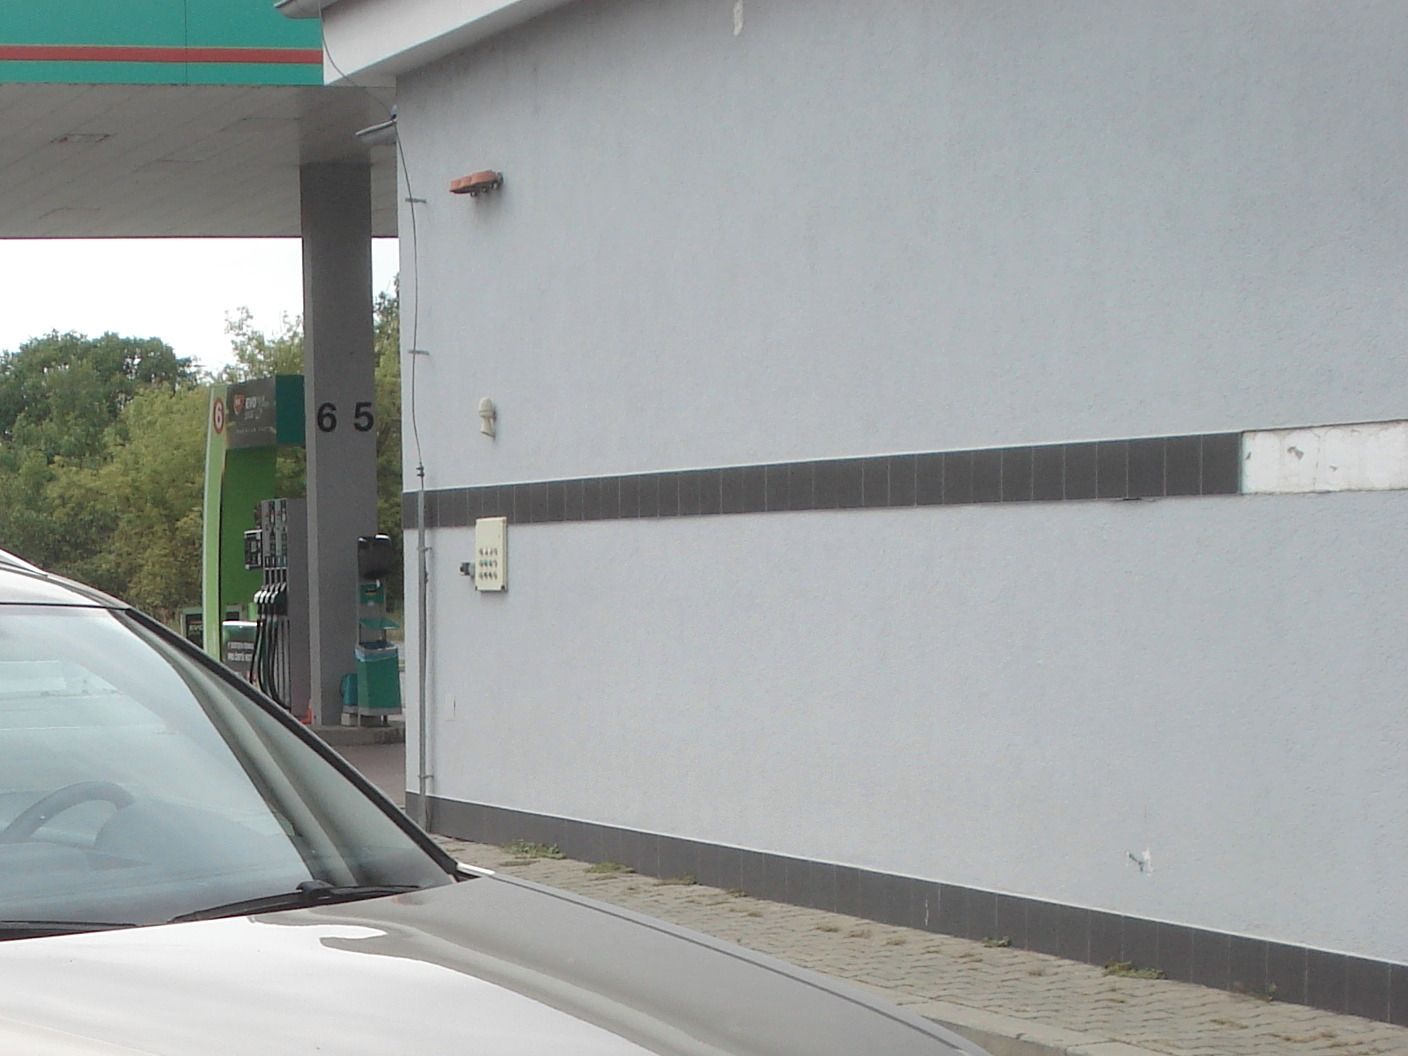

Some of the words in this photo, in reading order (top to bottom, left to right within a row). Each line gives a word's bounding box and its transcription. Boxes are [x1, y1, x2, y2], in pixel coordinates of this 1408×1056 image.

[215, 400, 223, 431] 6
[317, 402, 337, 432] 6
[353, 402, 374, 432] 5
